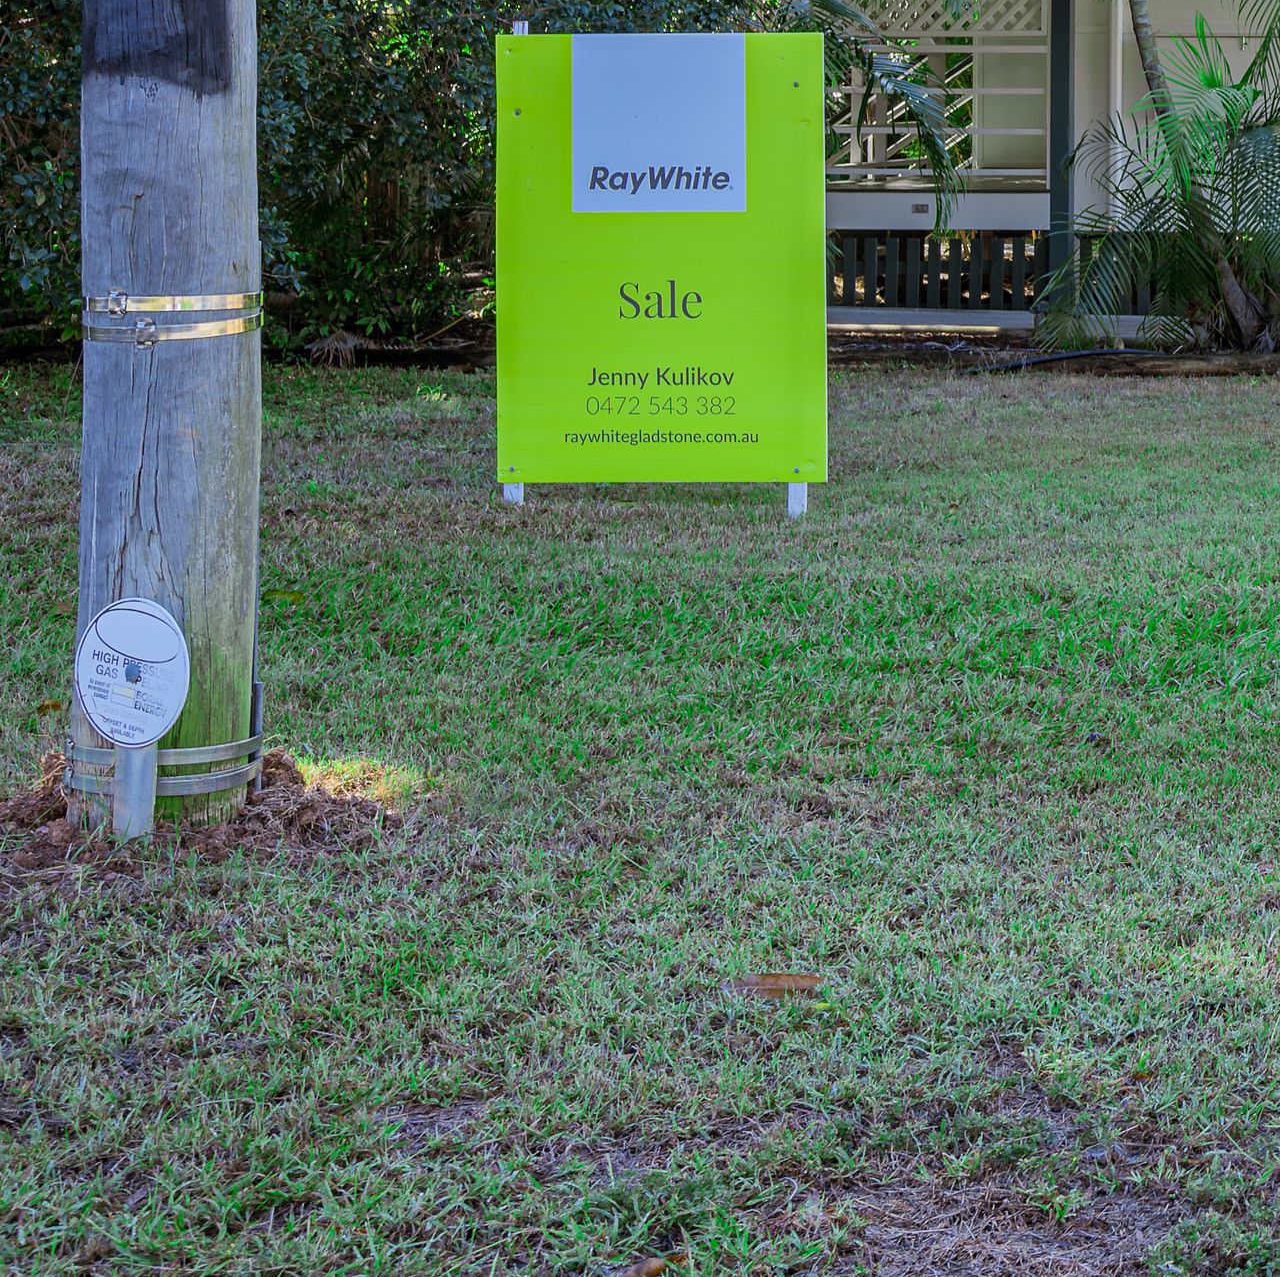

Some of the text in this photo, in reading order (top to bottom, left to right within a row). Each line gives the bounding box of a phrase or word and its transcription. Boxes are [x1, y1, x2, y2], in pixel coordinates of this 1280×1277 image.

[619, 279, 703, 319] Sale
[588, 367, 734, 390] Jenny Kulikov
[586, 396, 736, 415] 0472 543 382
[564, 429, 759, 446] raywhitegladstone.com.au
[92, 649, 119, 666] HIGH
[96, 664, 118, 679] GAS
